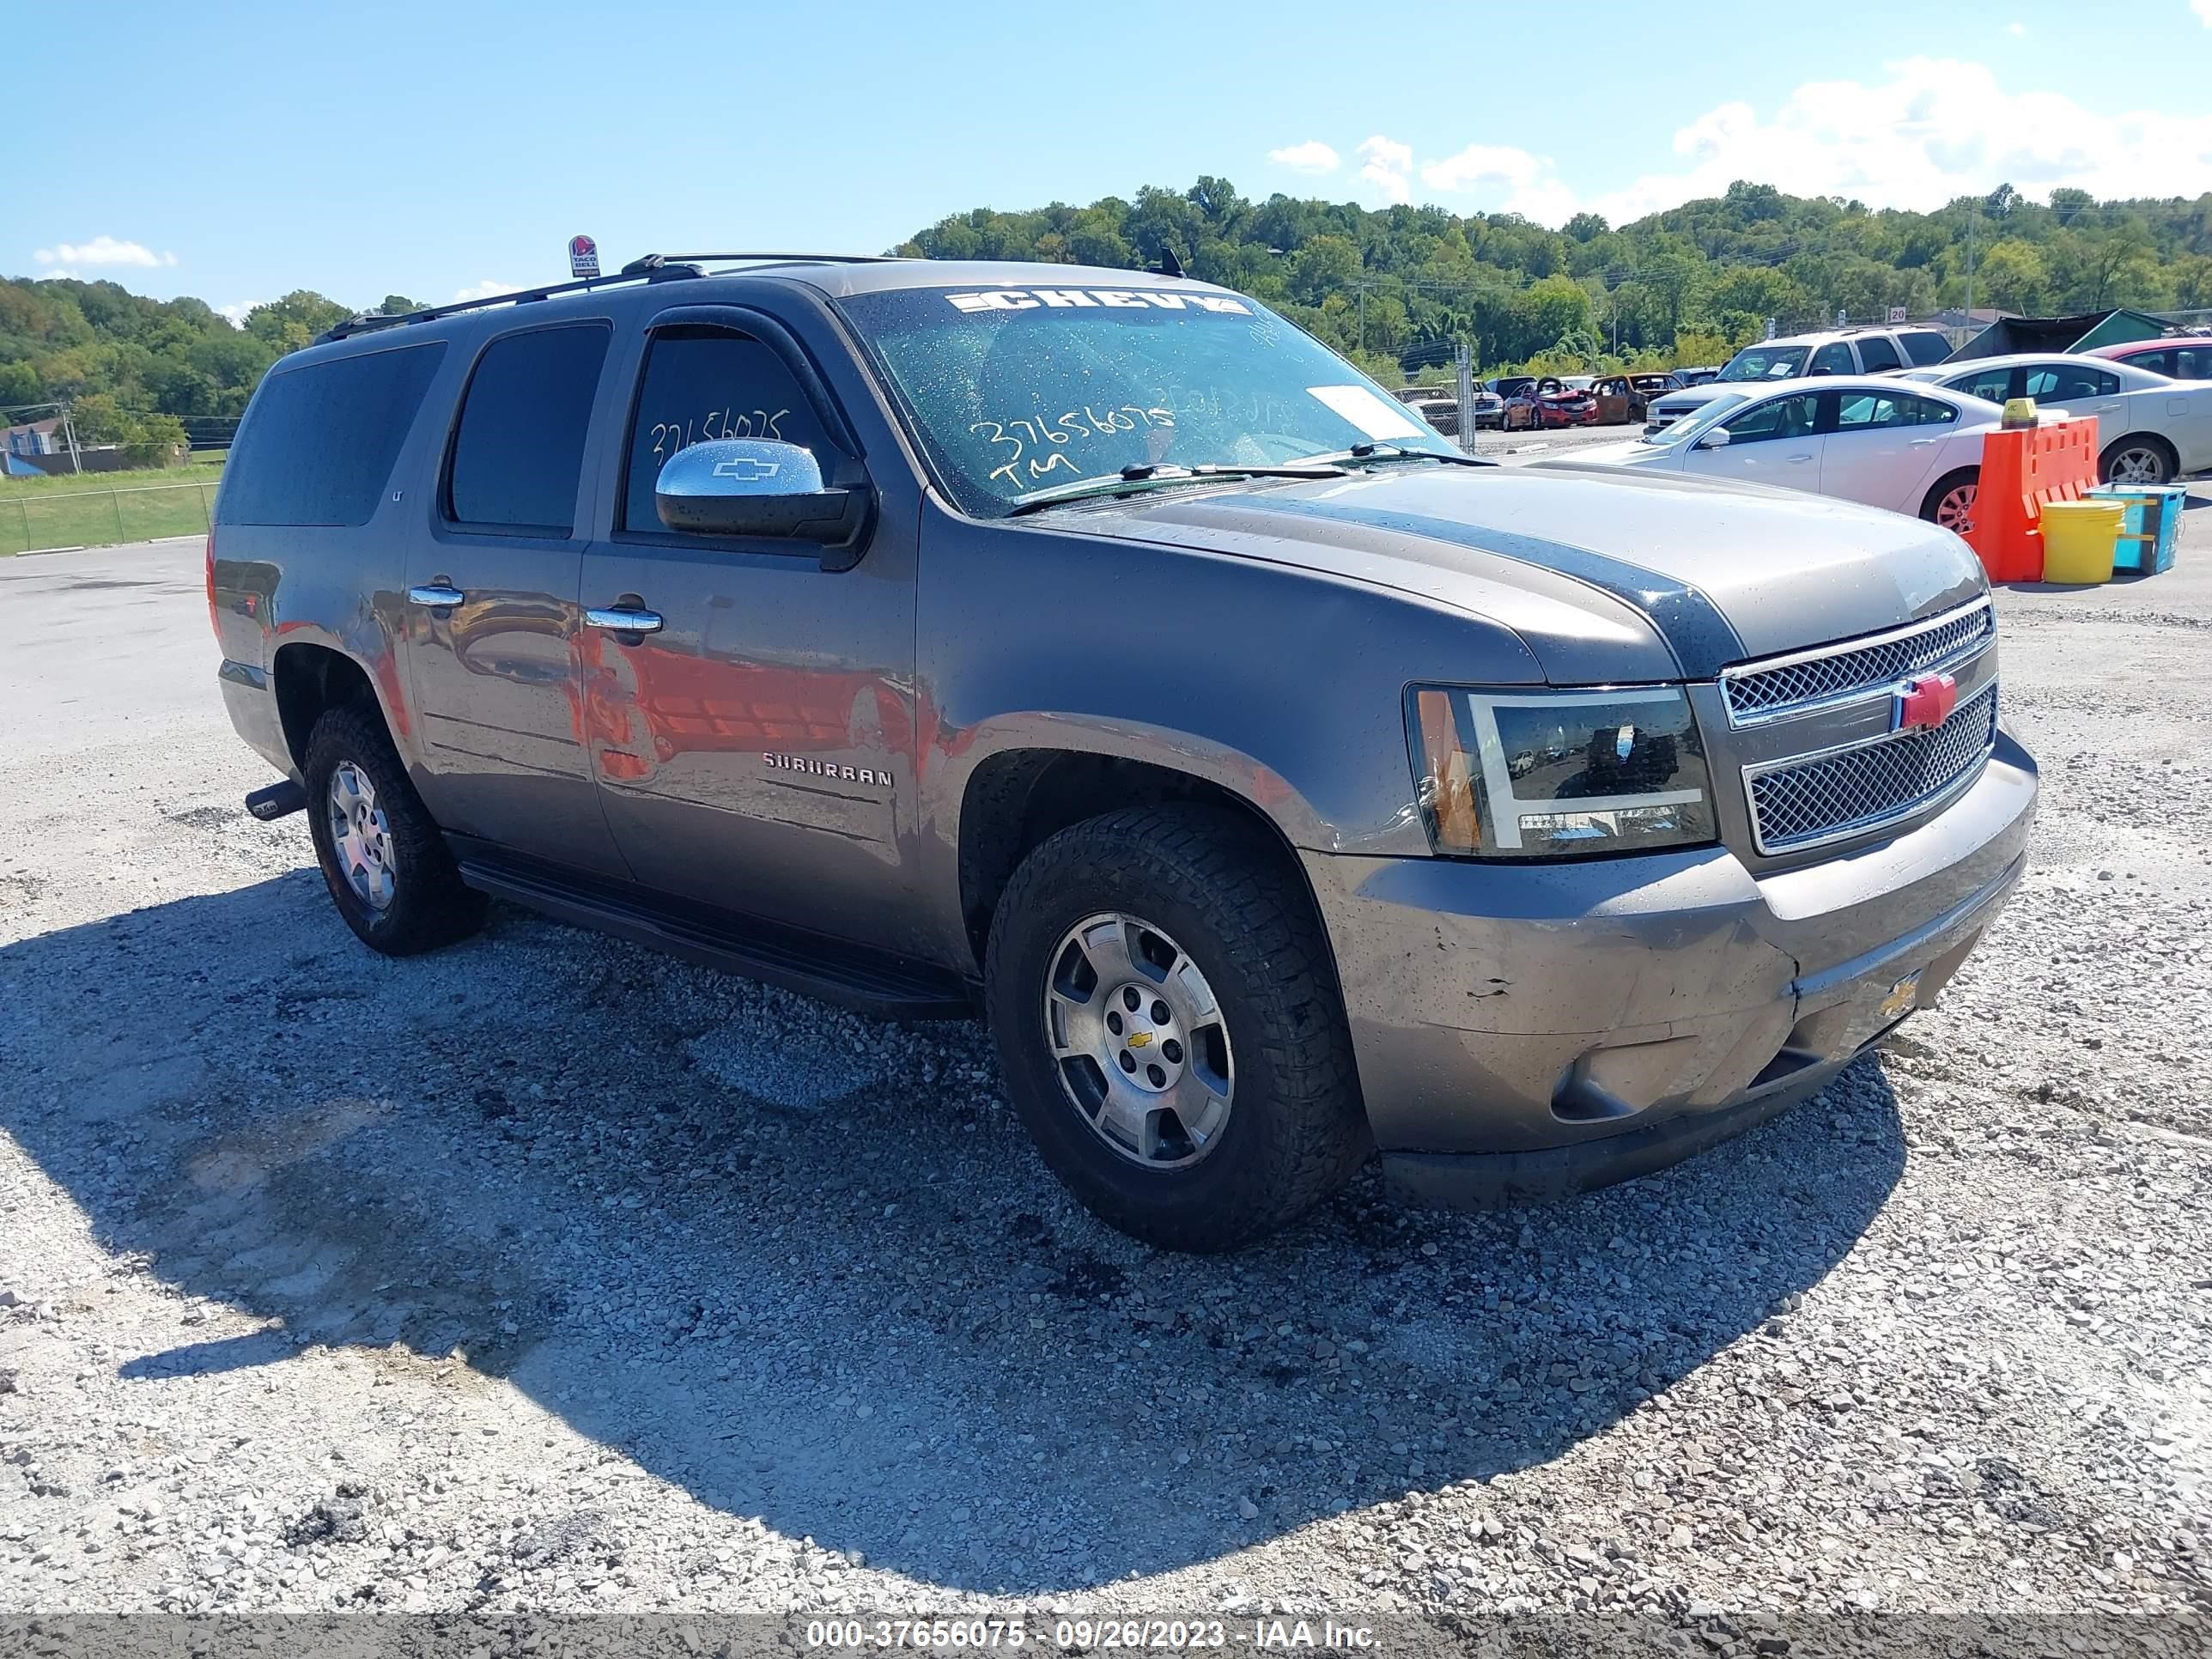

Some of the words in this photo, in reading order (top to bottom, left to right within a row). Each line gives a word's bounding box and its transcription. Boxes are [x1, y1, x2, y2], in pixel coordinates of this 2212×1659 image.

[945, 290, 1254, 317] CHEVY
[1892, 310, 1905, 319] 20
[969, 406, 1176, 460] 37656075
[989, 453, 1082, 489] TM
[392, 490, 404, 502] LT
[763, 751, 894, 788] SUBURBAN
